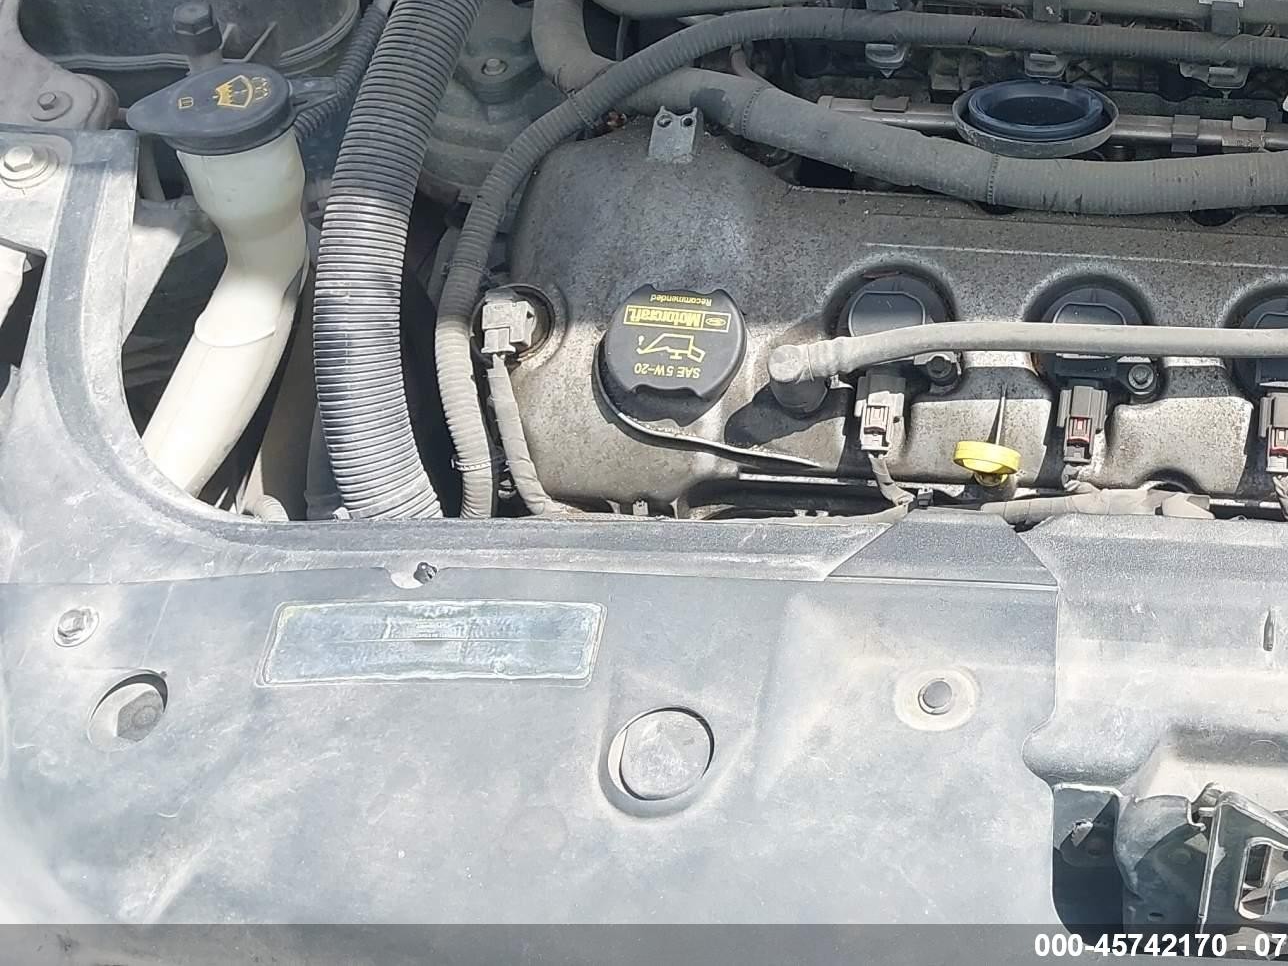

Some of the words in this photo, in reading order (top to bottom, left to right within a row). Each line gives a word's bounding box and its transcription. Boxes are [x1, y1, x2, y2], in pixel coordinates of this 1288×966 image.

[650, 294, 712, 306] Recommended
[629, 308, 702, 327] Motorcraft
[634, 362, 675, 377] 5W-20
[678, 366, 702, 379] SAE
